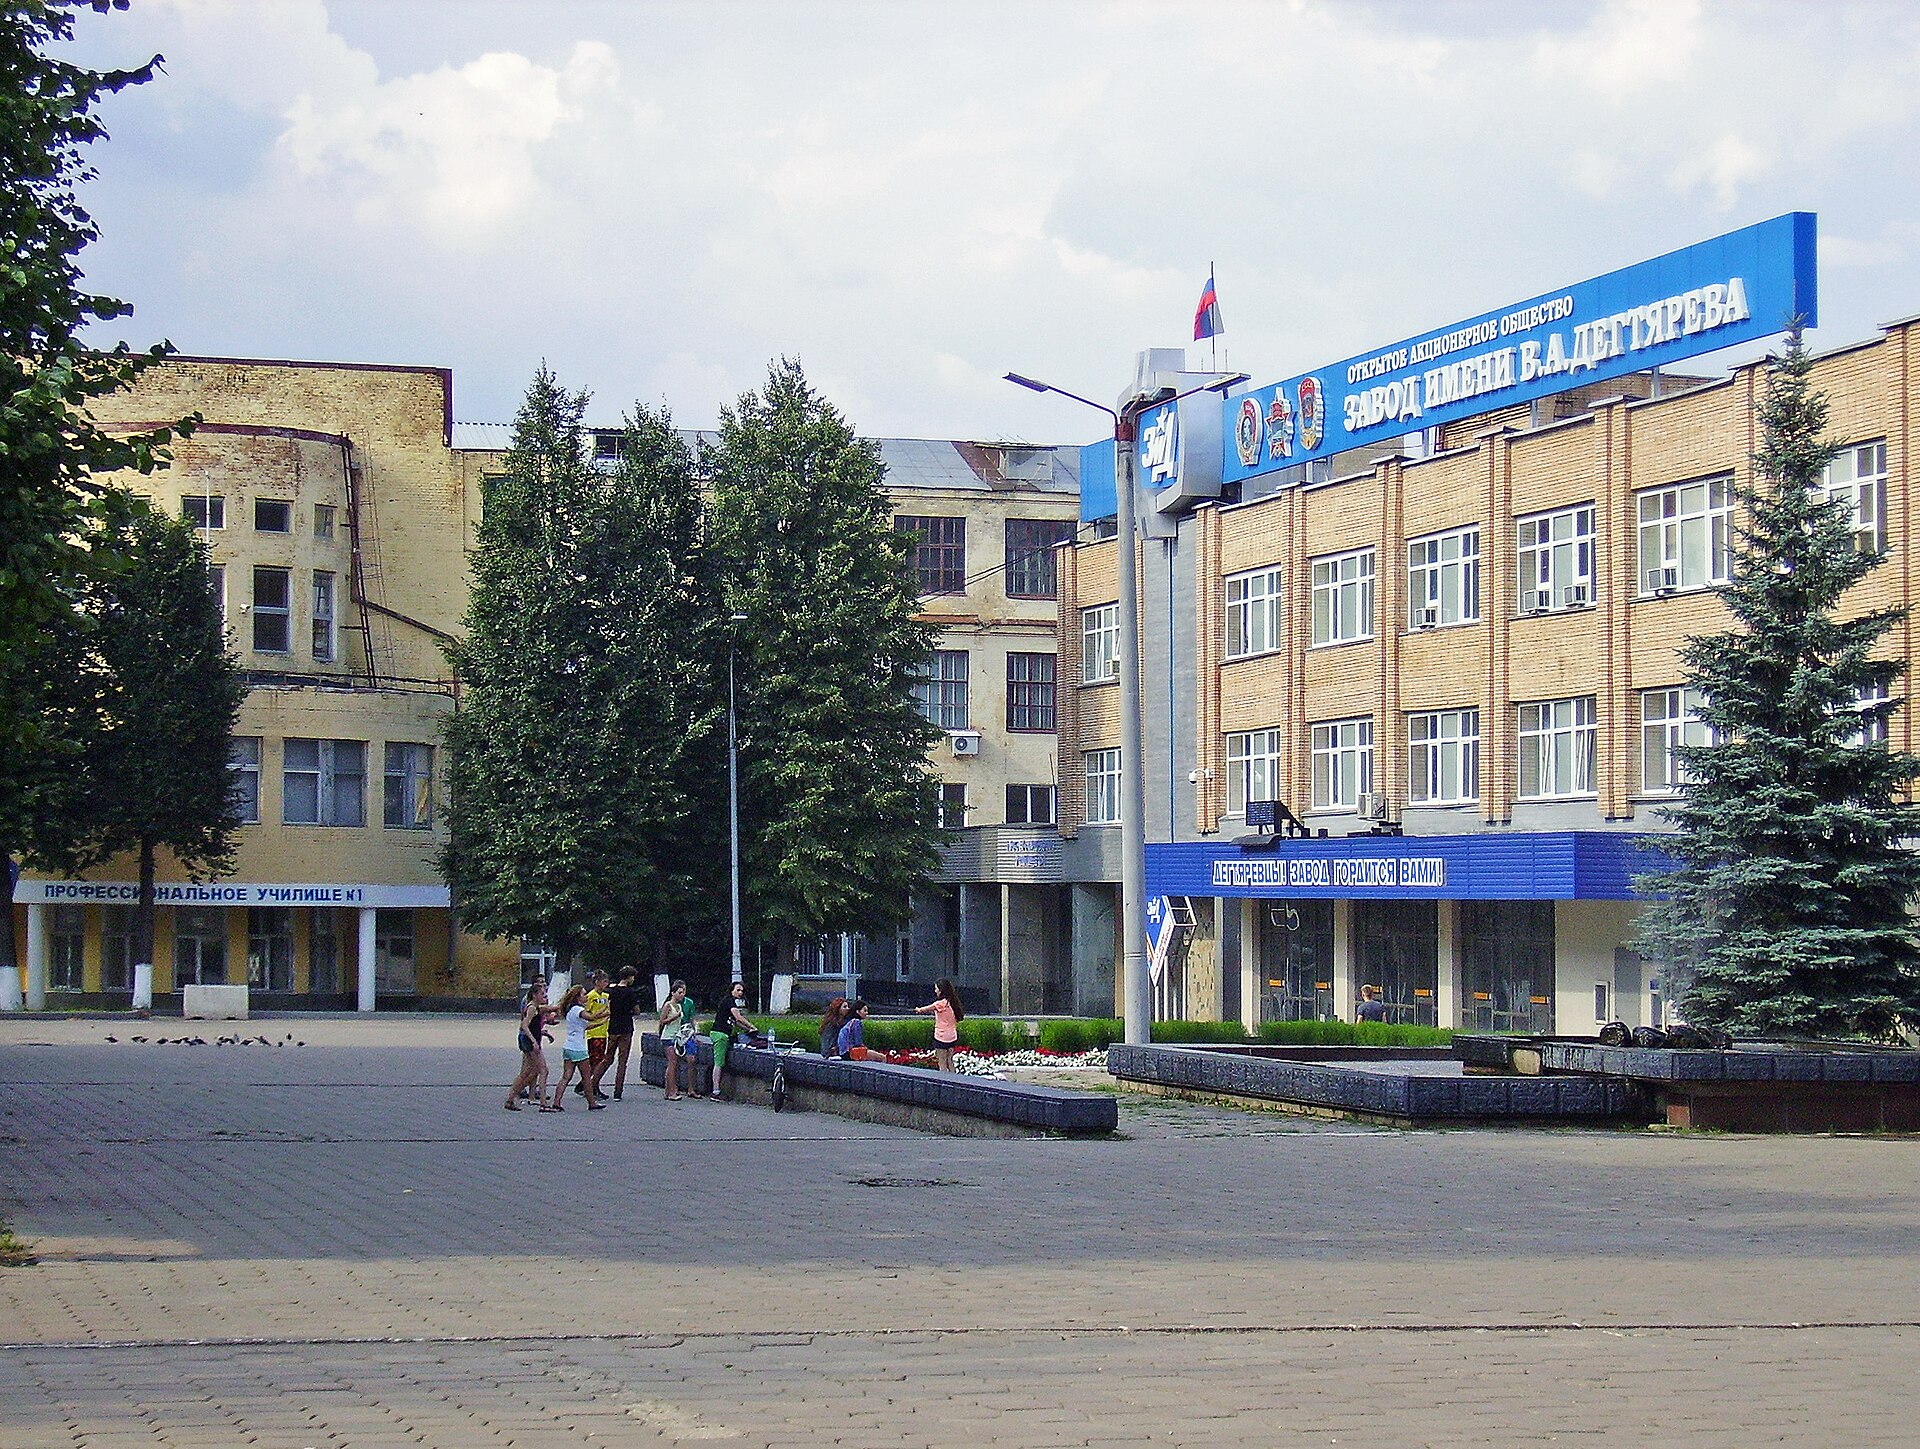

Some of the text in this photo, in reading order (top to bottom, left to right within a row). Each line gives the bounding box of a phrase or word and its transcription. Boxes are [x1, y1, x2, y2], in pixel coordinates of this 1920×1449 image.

[1347, 295, 1575, 384] ОТКРЫТОЕ АКЦИОНЕРНОЕ ОБЩЕСТВО
[1343, 375, 1424, 433] ЗАВОД
[1423, 347, 1518, 409] ИМЕНИ
[257, 887, 342, 901] УЧИЛИЩЕ
[1290, 859, 1330, 886] ЗАВОД
[1333, 859, 1397, 886] ГОРДИТСЯ
[1399, 858, 1443, 887] ВАМИ!
